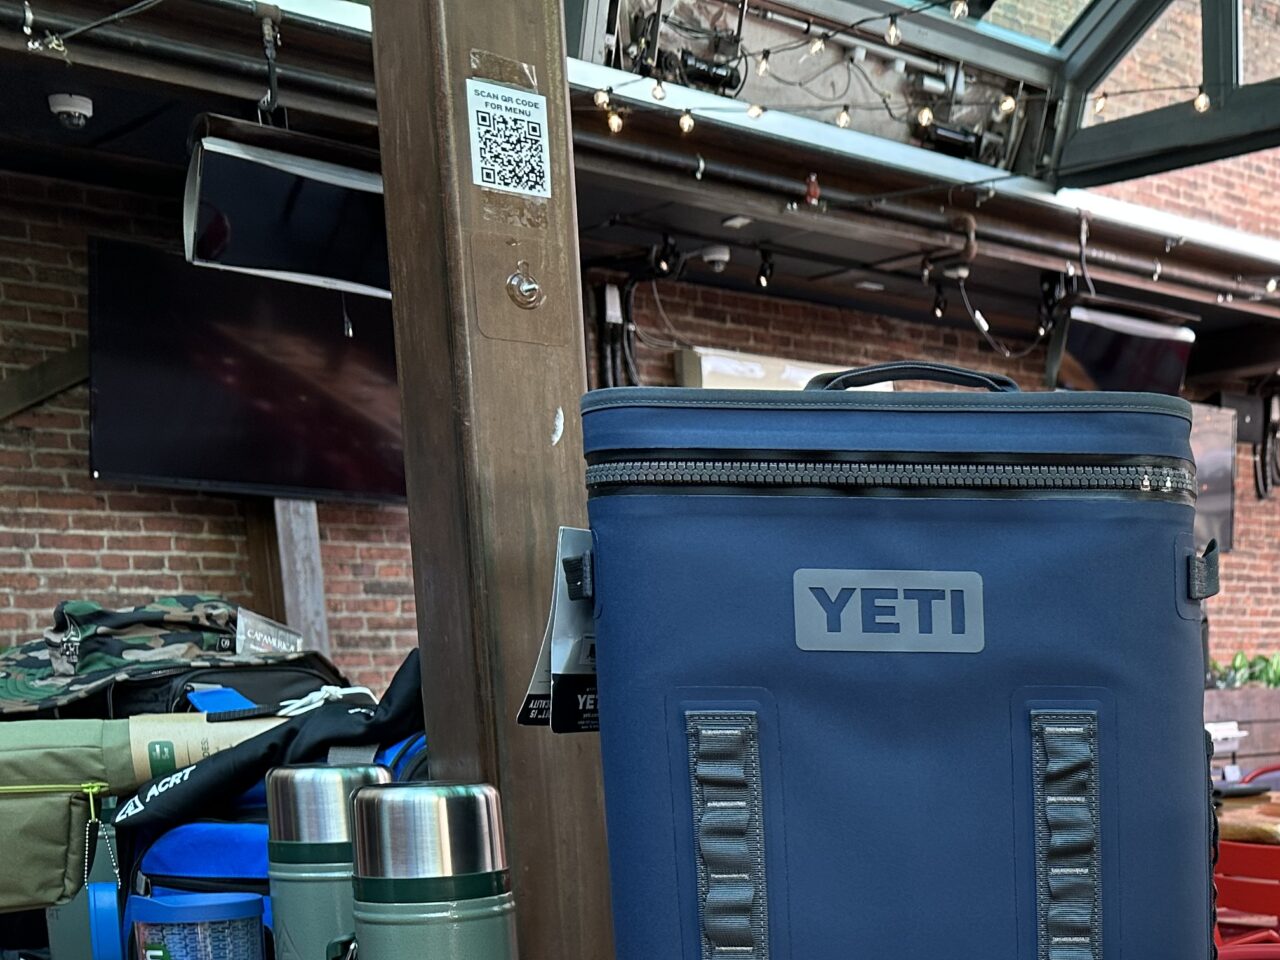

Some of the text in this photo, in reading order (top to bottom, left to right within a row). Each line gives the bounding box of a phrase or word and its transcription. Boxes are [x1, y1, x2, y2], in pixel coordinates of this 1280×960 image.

[474, 89, 540, 110] SCAN QR CODE
[484, 101, 532, 117] FOR MENU
[808, 586, 966, 635] YETI
[145, 764, 197, 803] ACRT
